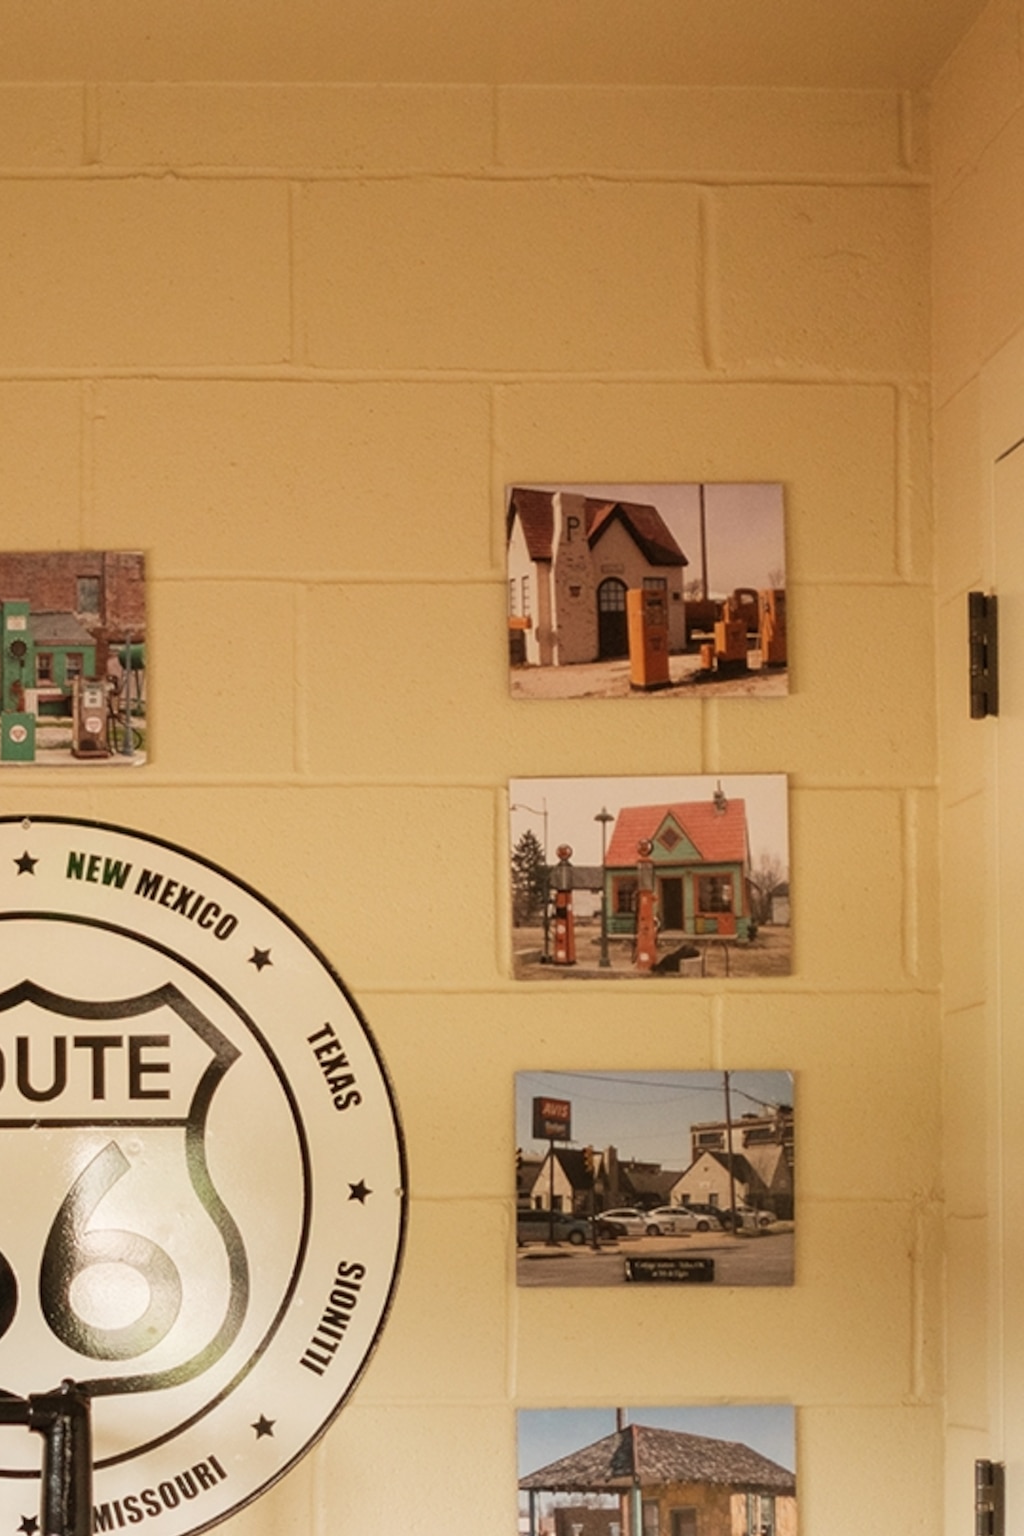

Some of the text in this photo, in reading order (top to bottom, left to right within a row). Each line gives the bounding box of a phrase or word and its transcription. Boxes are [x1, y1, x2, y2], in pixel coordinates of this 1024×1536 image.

[66, 851, 239, 941] NEW MEXICO
[307, 1022, 362, 1112] TEXAS
[299, 1260, 367, 1377] ILLINOIS
[93, 1454, 228, 1535] MISSOURI
